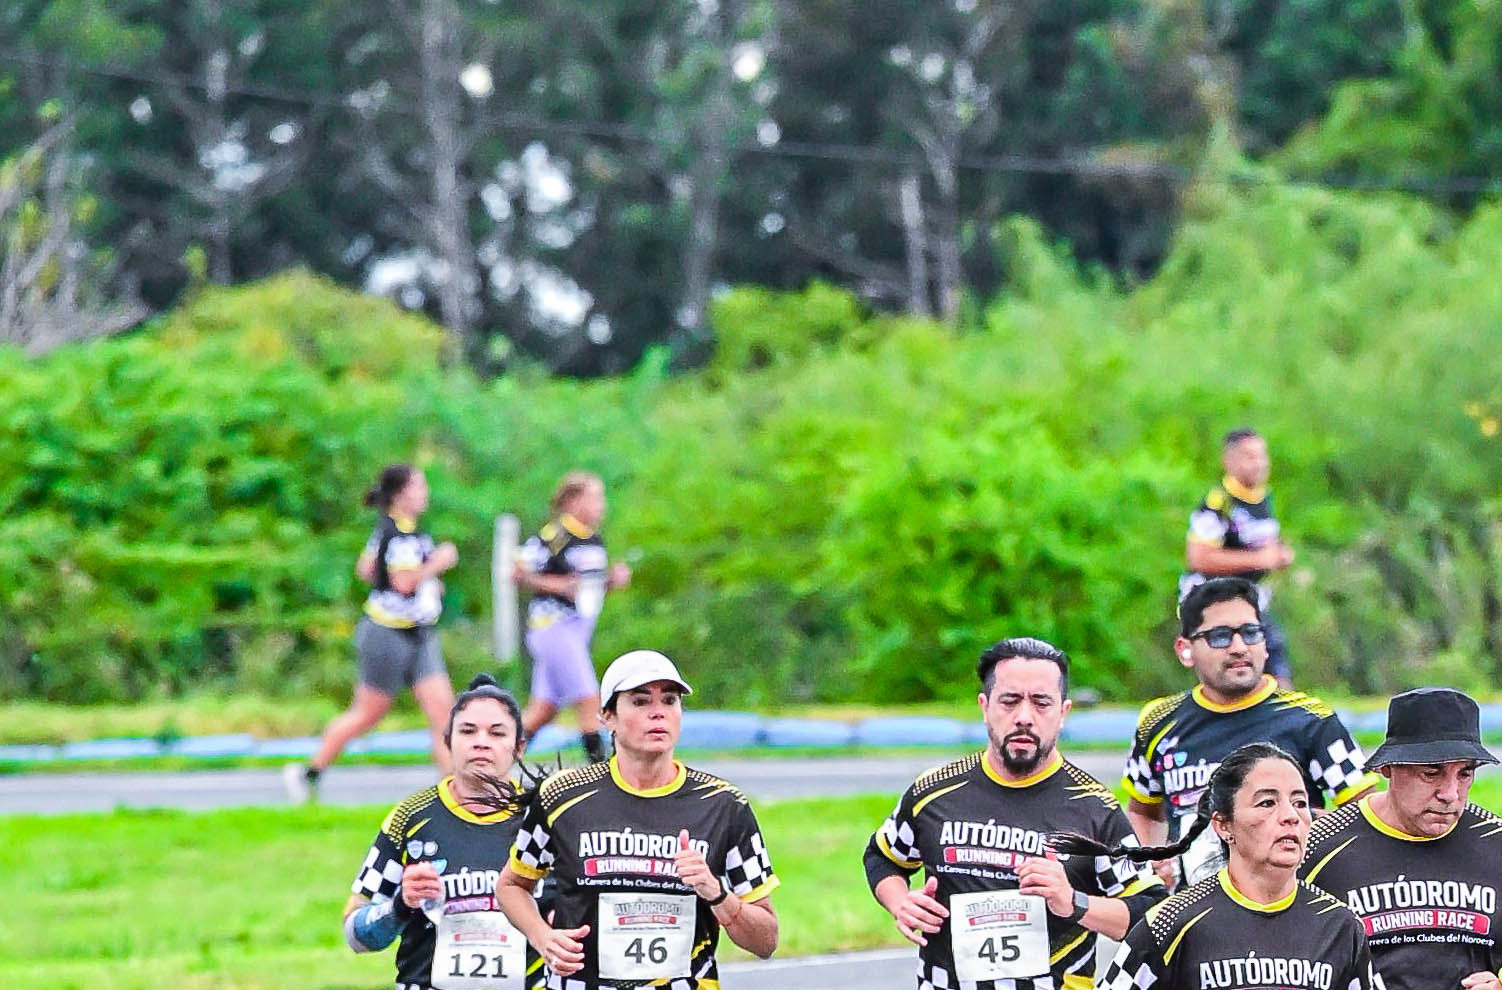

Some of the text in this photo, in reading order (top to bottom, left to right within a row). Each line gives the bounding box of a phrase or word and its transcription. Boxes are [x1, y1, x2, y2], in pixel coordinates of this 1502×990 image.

[578, 827, 710, 861] AUTÓDROO
[940, 818, 1070, 861] AUTÓDRO
[596, 858, 652, 874] RUNNING
[956, 847, 1012, 866] RUNNING
[1346, 874, 1496, 915] AUTÓDROMO
[1371, 910, 1477, 933] RUNNING RACE
[624, 937, 668, 964] 46
[978, 935, 1021, 964] 45
[1391, 935, 1403, 945] de
[1403, 935, 1416, 943] los
[1416, 933, 1446, 943] Clubes
[1446, 933, 1461, 943] del
[448, 953, 509, 979] 121
[1199, 950, 1333, 990] AUTÓDROMO
